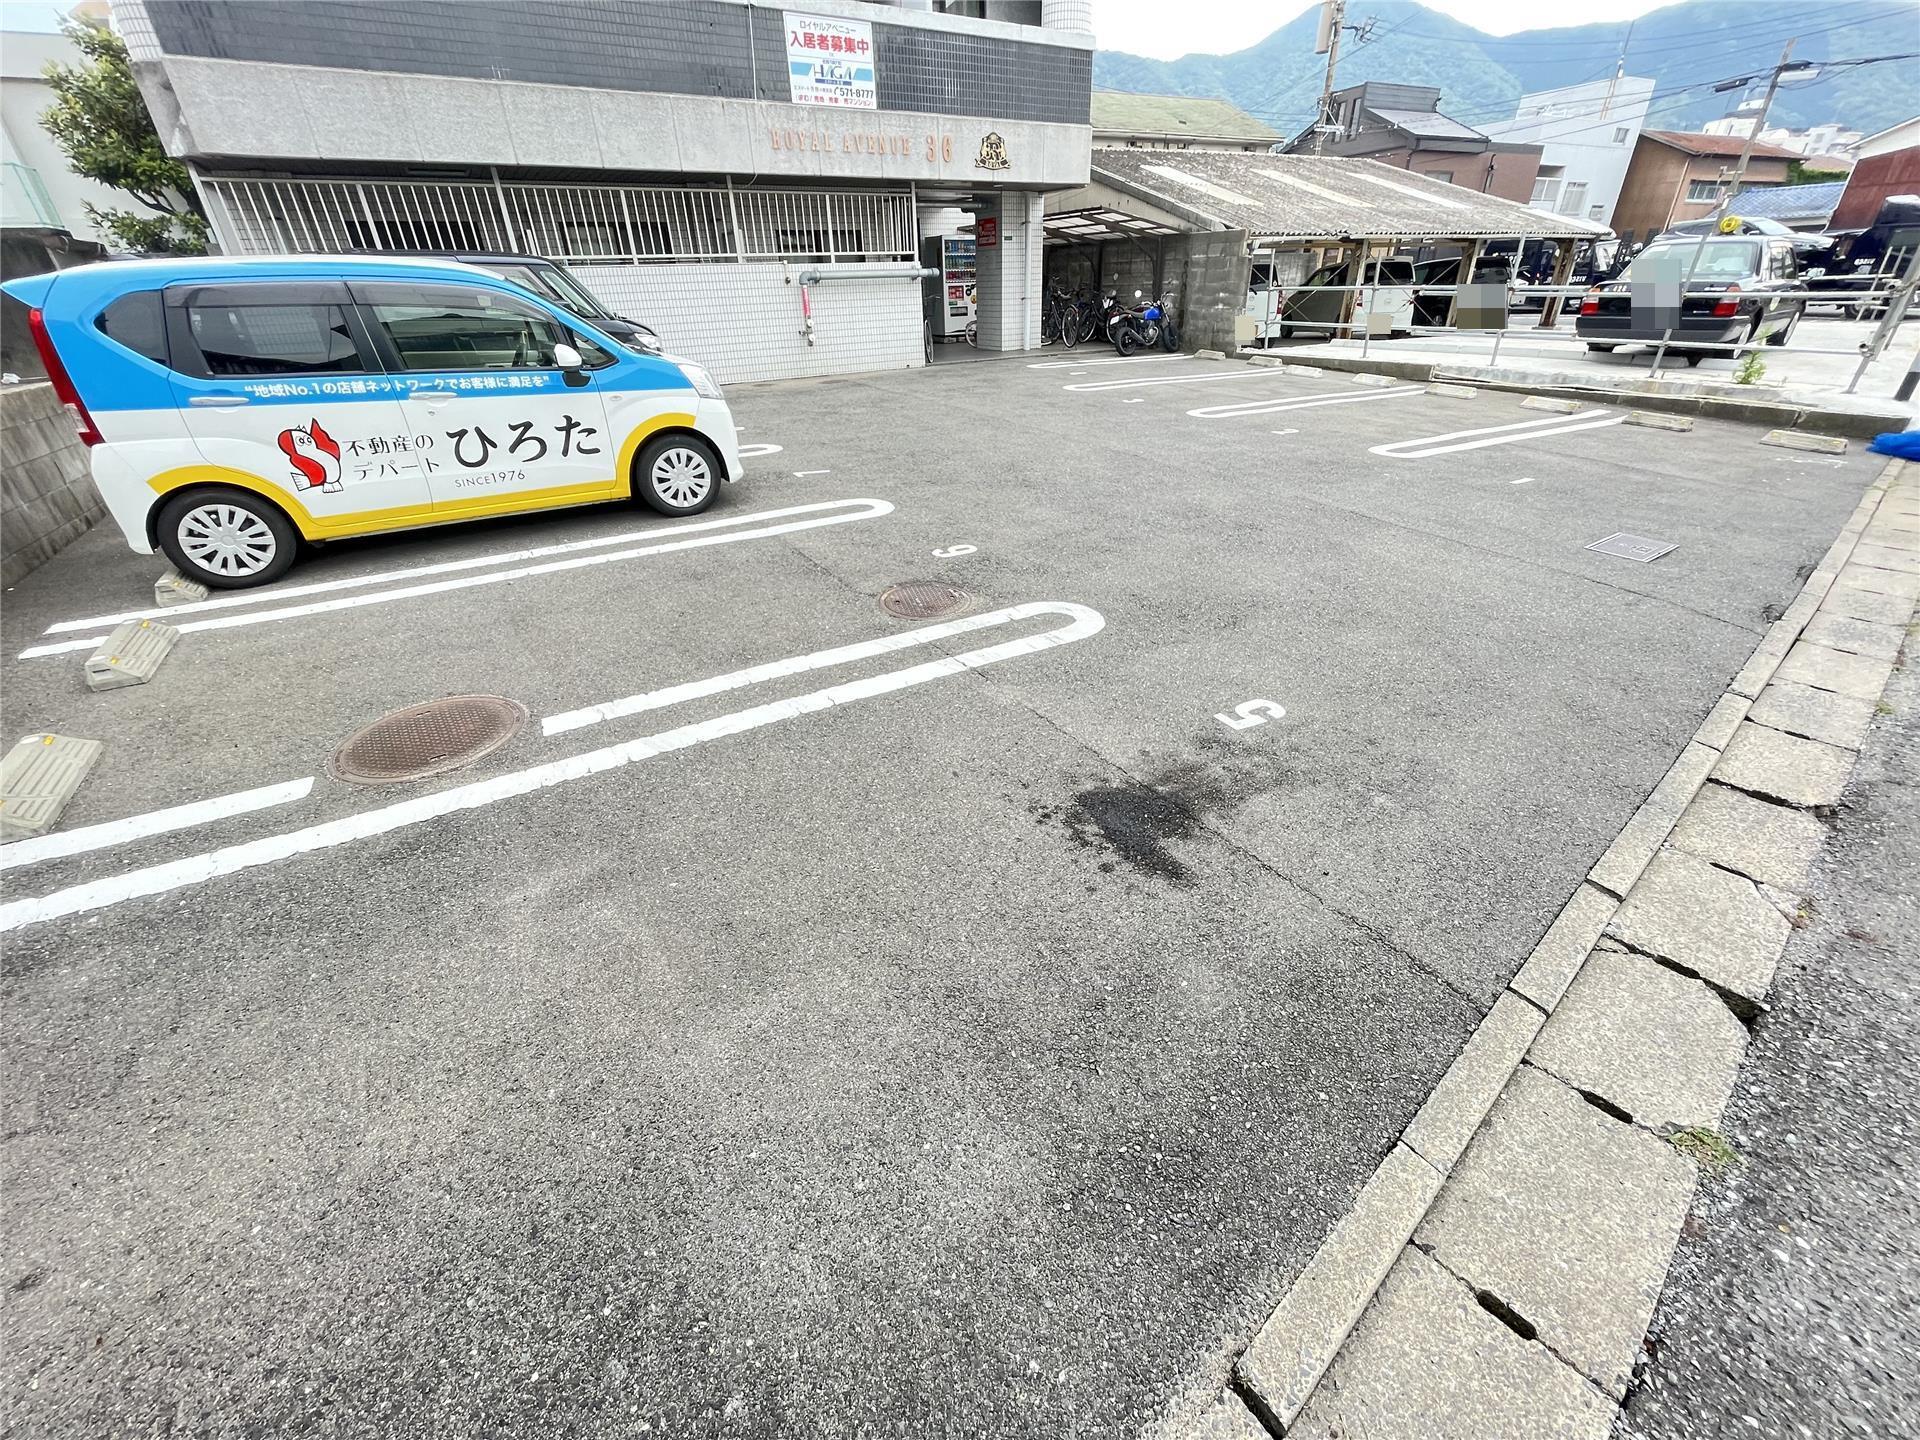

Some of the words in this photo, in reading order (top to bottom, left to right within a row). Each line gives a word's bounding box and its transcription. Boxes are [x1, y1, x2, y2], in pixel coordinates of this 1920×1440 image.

[799, 20, 857, 34] ロイヤルアベニュー
[790, 31, 869, 55] 入居者募集中
[839, 86, 874, 99] 571-8777
[769, 128, 833, 152] ROYAL
[842, 132, 911, 156] AVENUE
[925, 134, 954, 163] 36
[342, 434, 434, 457] 不動産の
[446, 414, 601, 468] ひろた
[353, 457, 440, 481] デパート
[1213, 698, 1287, 730] 5
